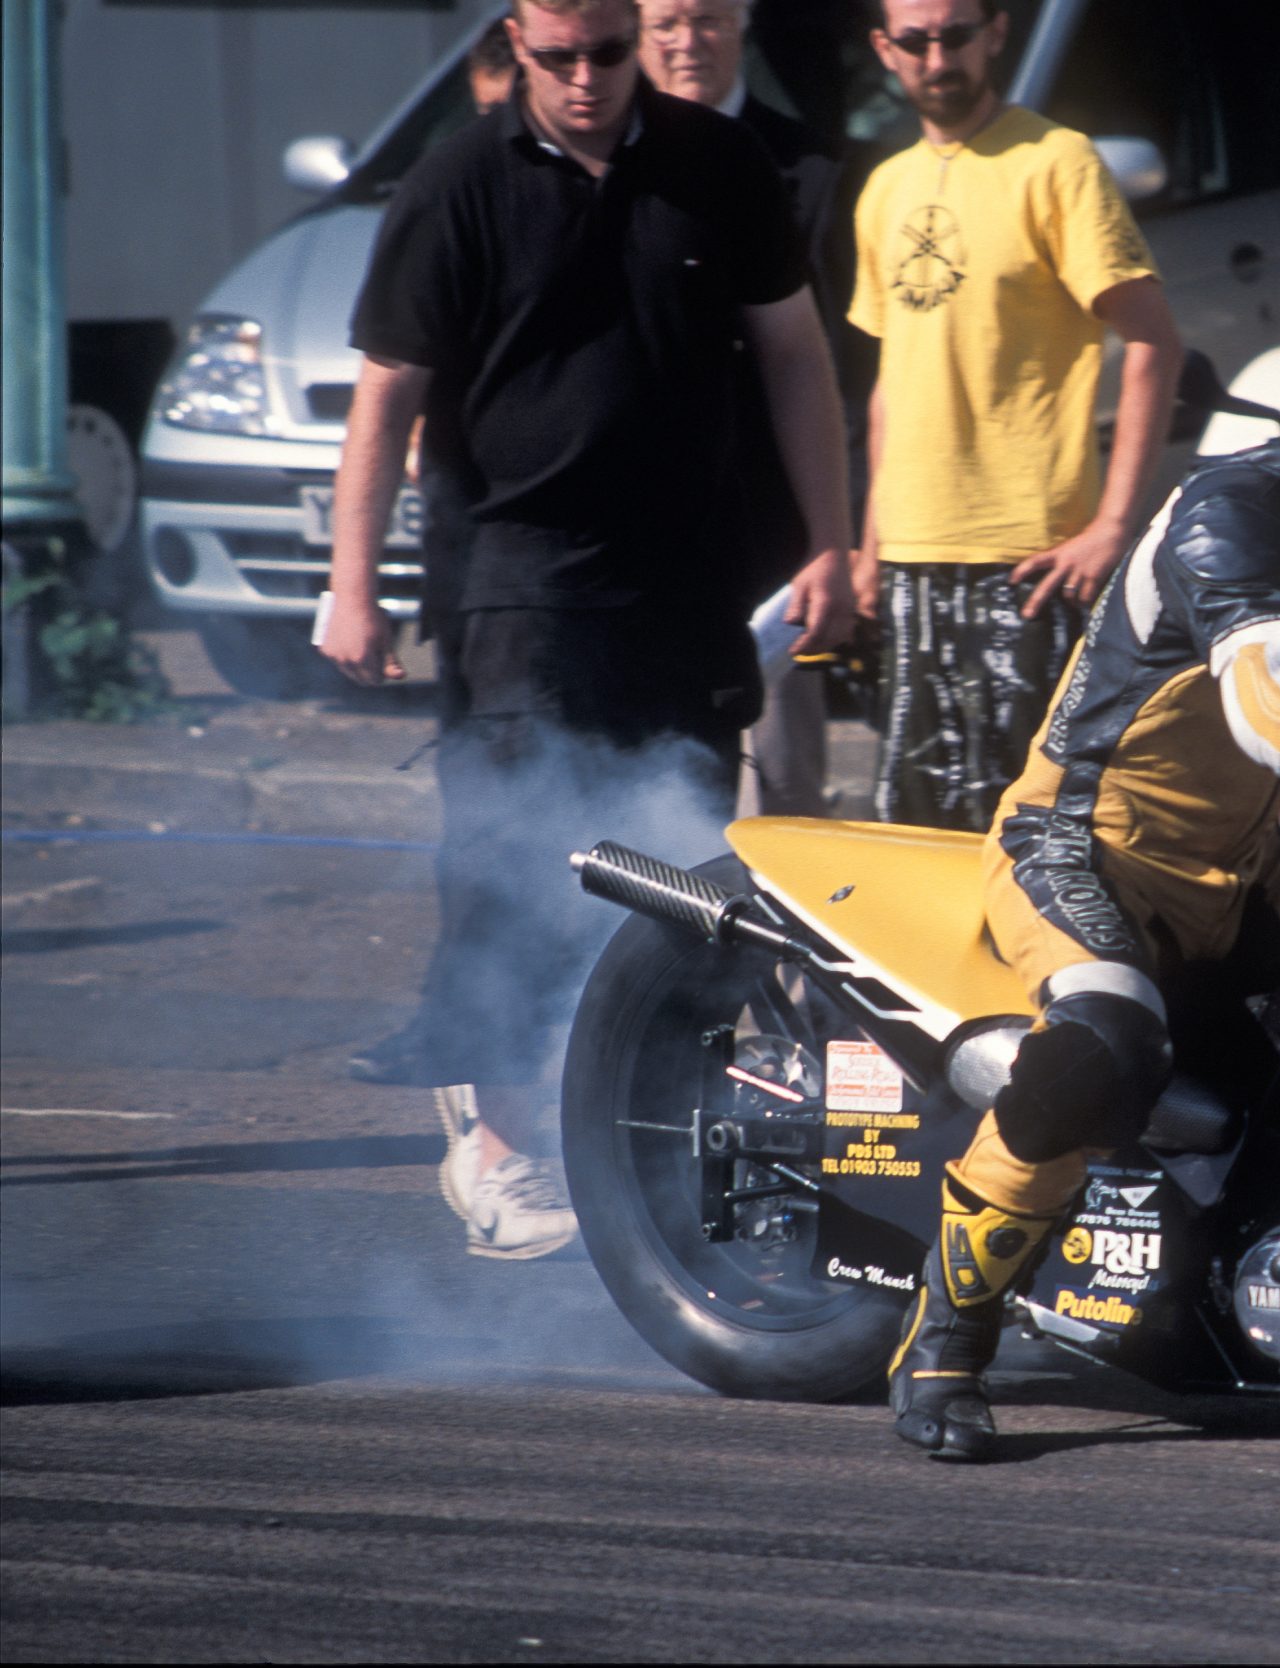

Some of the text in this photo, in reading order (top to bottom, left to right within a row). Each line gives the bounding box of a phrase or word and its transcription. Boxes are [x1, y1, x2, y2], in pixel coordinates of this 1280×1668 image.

[826, 1112, 873, 1127] PROTOTYPE
[863, 1129, 880, 1143] BY
[873, 1145, 897, 1159] LTD
[822, 1158, 839, 1174] TEL
[840, 1158, 876, 1175] 01903
[1091, 1229, 1162, 1275] P&H
[827, 1257, 862, 1279] Crew
[1055, 1290, 1143, 1325] Putoline
